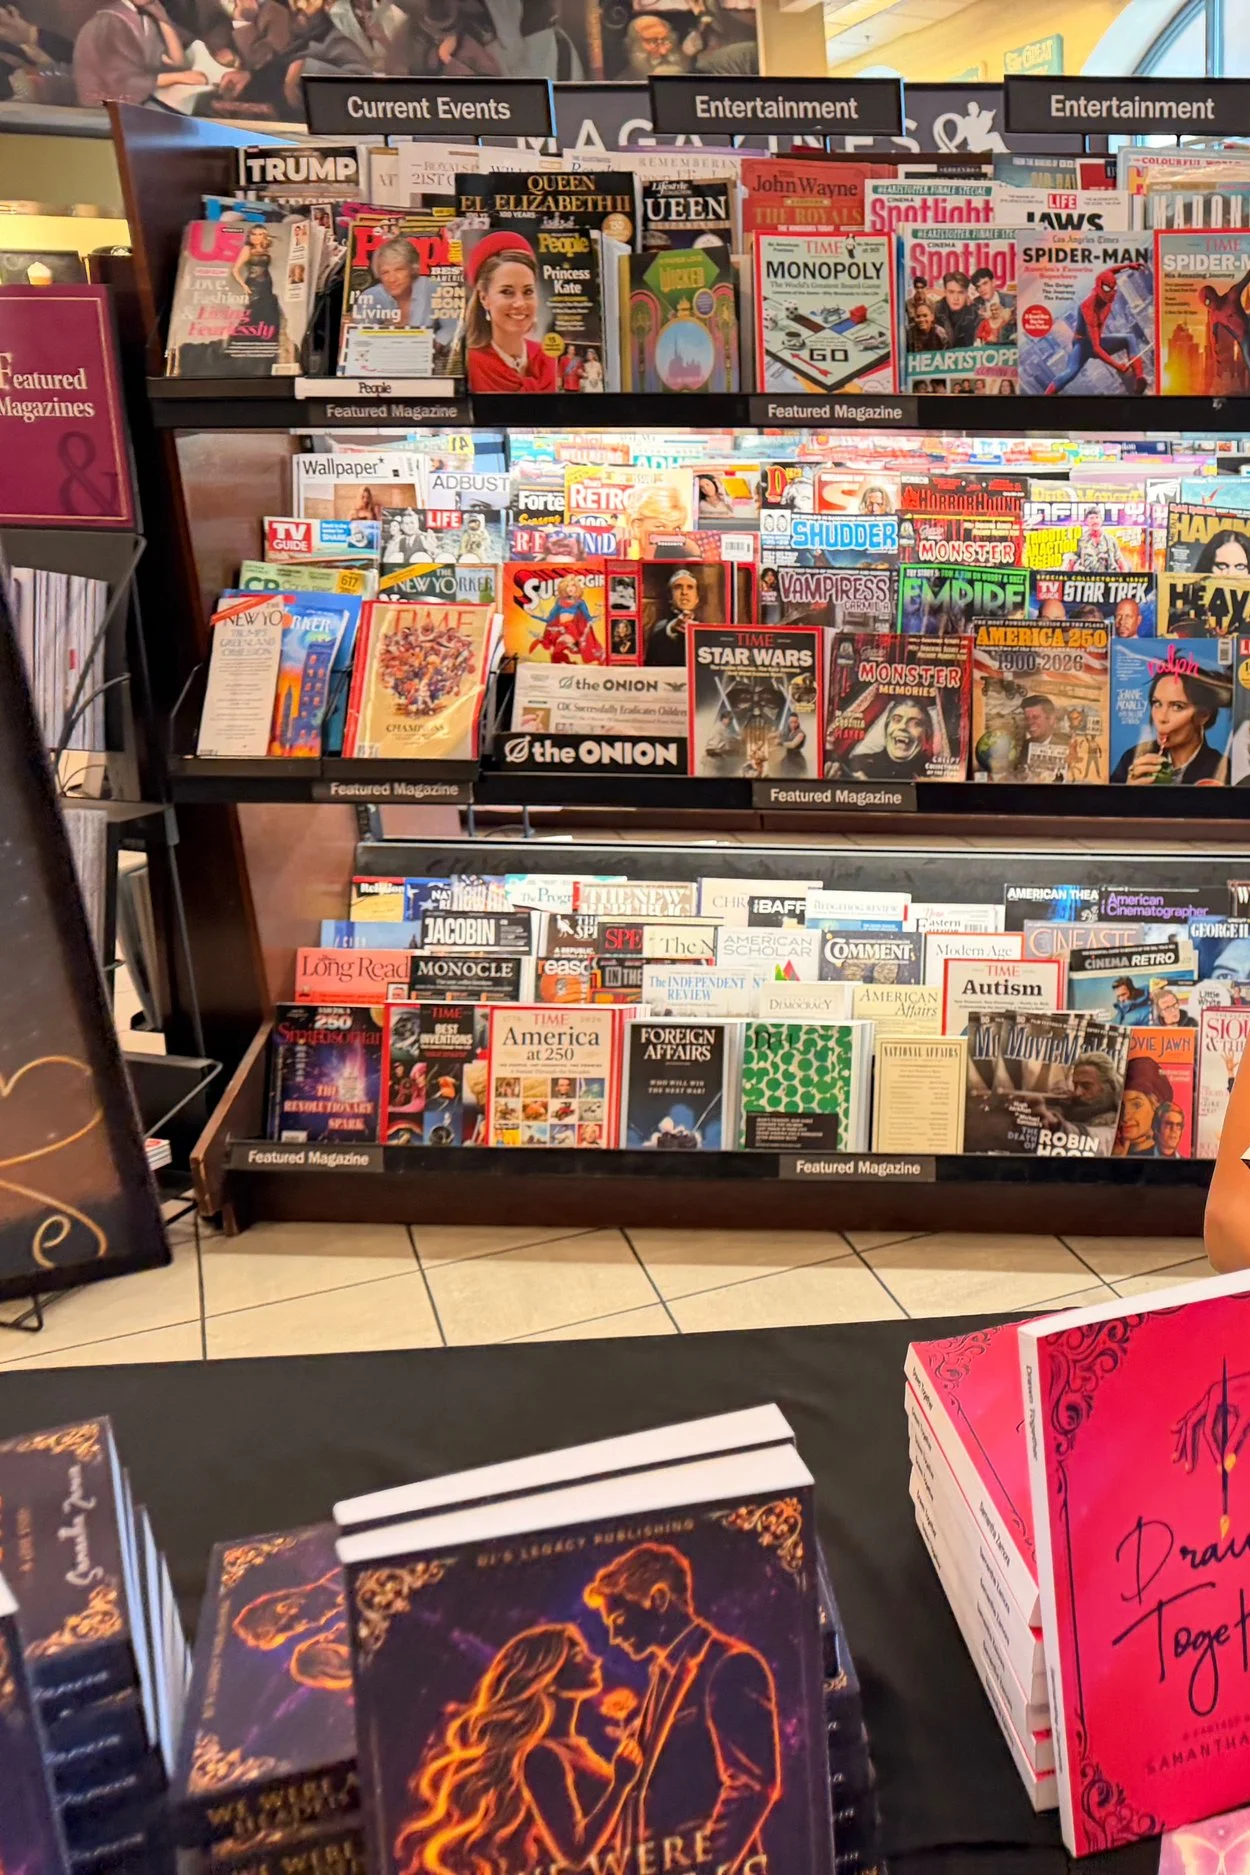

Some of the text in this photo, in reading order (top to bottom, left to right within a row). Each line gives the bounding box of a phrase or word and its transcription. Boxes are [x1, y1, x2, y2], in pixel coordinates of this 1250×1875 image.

[348, 97, 510, 120] Current Events
[696, 96, 858, 119] Entertainment
[1051, 95, 1214, 119] Entertainment
[246, 157, 356, 184] TRUMP
[527, 176, 595, 192] QUEEN
[752, 175, 858, 197] John Wayne
[1048, 194, 1077, 209] LIFE
[806, 241, 843, 254] TIME
[1023, 247, 1148, 264] SPIDER-MAN
[543, 266, 590, 281] Princess
[766, 262, 884, 280] MONOPOLY
[554, 281, 582, 294] Kate
[0, 352, 87, 389] Featured
[0, 397, 95, 422] Magazines
[327, 405, 457, 419] Featured Magazine
[768, 405, 901, 420] Featured Magazine
[428, 511, 461, 528] LIFE
[272, 522, 307, 539] TV
[791, 520, 898, 551] SHUDDER
[272, 539, 307, 552] GUIDE
[977, 628, 1107, 648] AMERICA 250
[698, 648, 813, 667] STAR WARS
[858, 662, 961, 687] MONSTER
[575, 679, 658, 692] the ONION
[879, 686, 936, 696] MEMORIES
[533, 741, 677, 766] the ONION
[331, 783, 458, 797] Featured Magazine
[770, 789, 901, 805] Featured Magazine
[1008, 888, 1067, 900] AMERICAN
[424, 918, 495, 945] JACOBIN
[723, 935, 812, 946] AMERICAN
[723, 945, 813, 957] SCHOLAR
[417, 960, 513, 977] MONOCLE
[1085, 952, 1175, 969] CINEMA RETRO
[985, 965, 1020, 977] TIME
[668, 975, 745, 989] INDEPENDENT
[962, 979, 1042, 997] Autism
[668, 989, 712, 1001] REVIEW
[534, 1013, 568, 1026] TIME
[435, 1023, 459, 1034] BEST
[503, 1026, 600, 1047] America
[640, 1028, 716, 1044] FOREIGN
[421, 1034, 473, 1045] INVENTIONS
[527, 1048, 574, 1061] at 250
[644, 1043, 712, 1061] AFFAIRS
[884, 1046, 958, 1059] NATIONAL AFFAIRS
[284, 1101, 373, 1114] REVOLUTIONARY
[328, 1118, 365, 1129] SPARK
[249, 1151, 369, 1167] Featured Magazine
[796, 1161, 921, 1176] Featured Magazine
